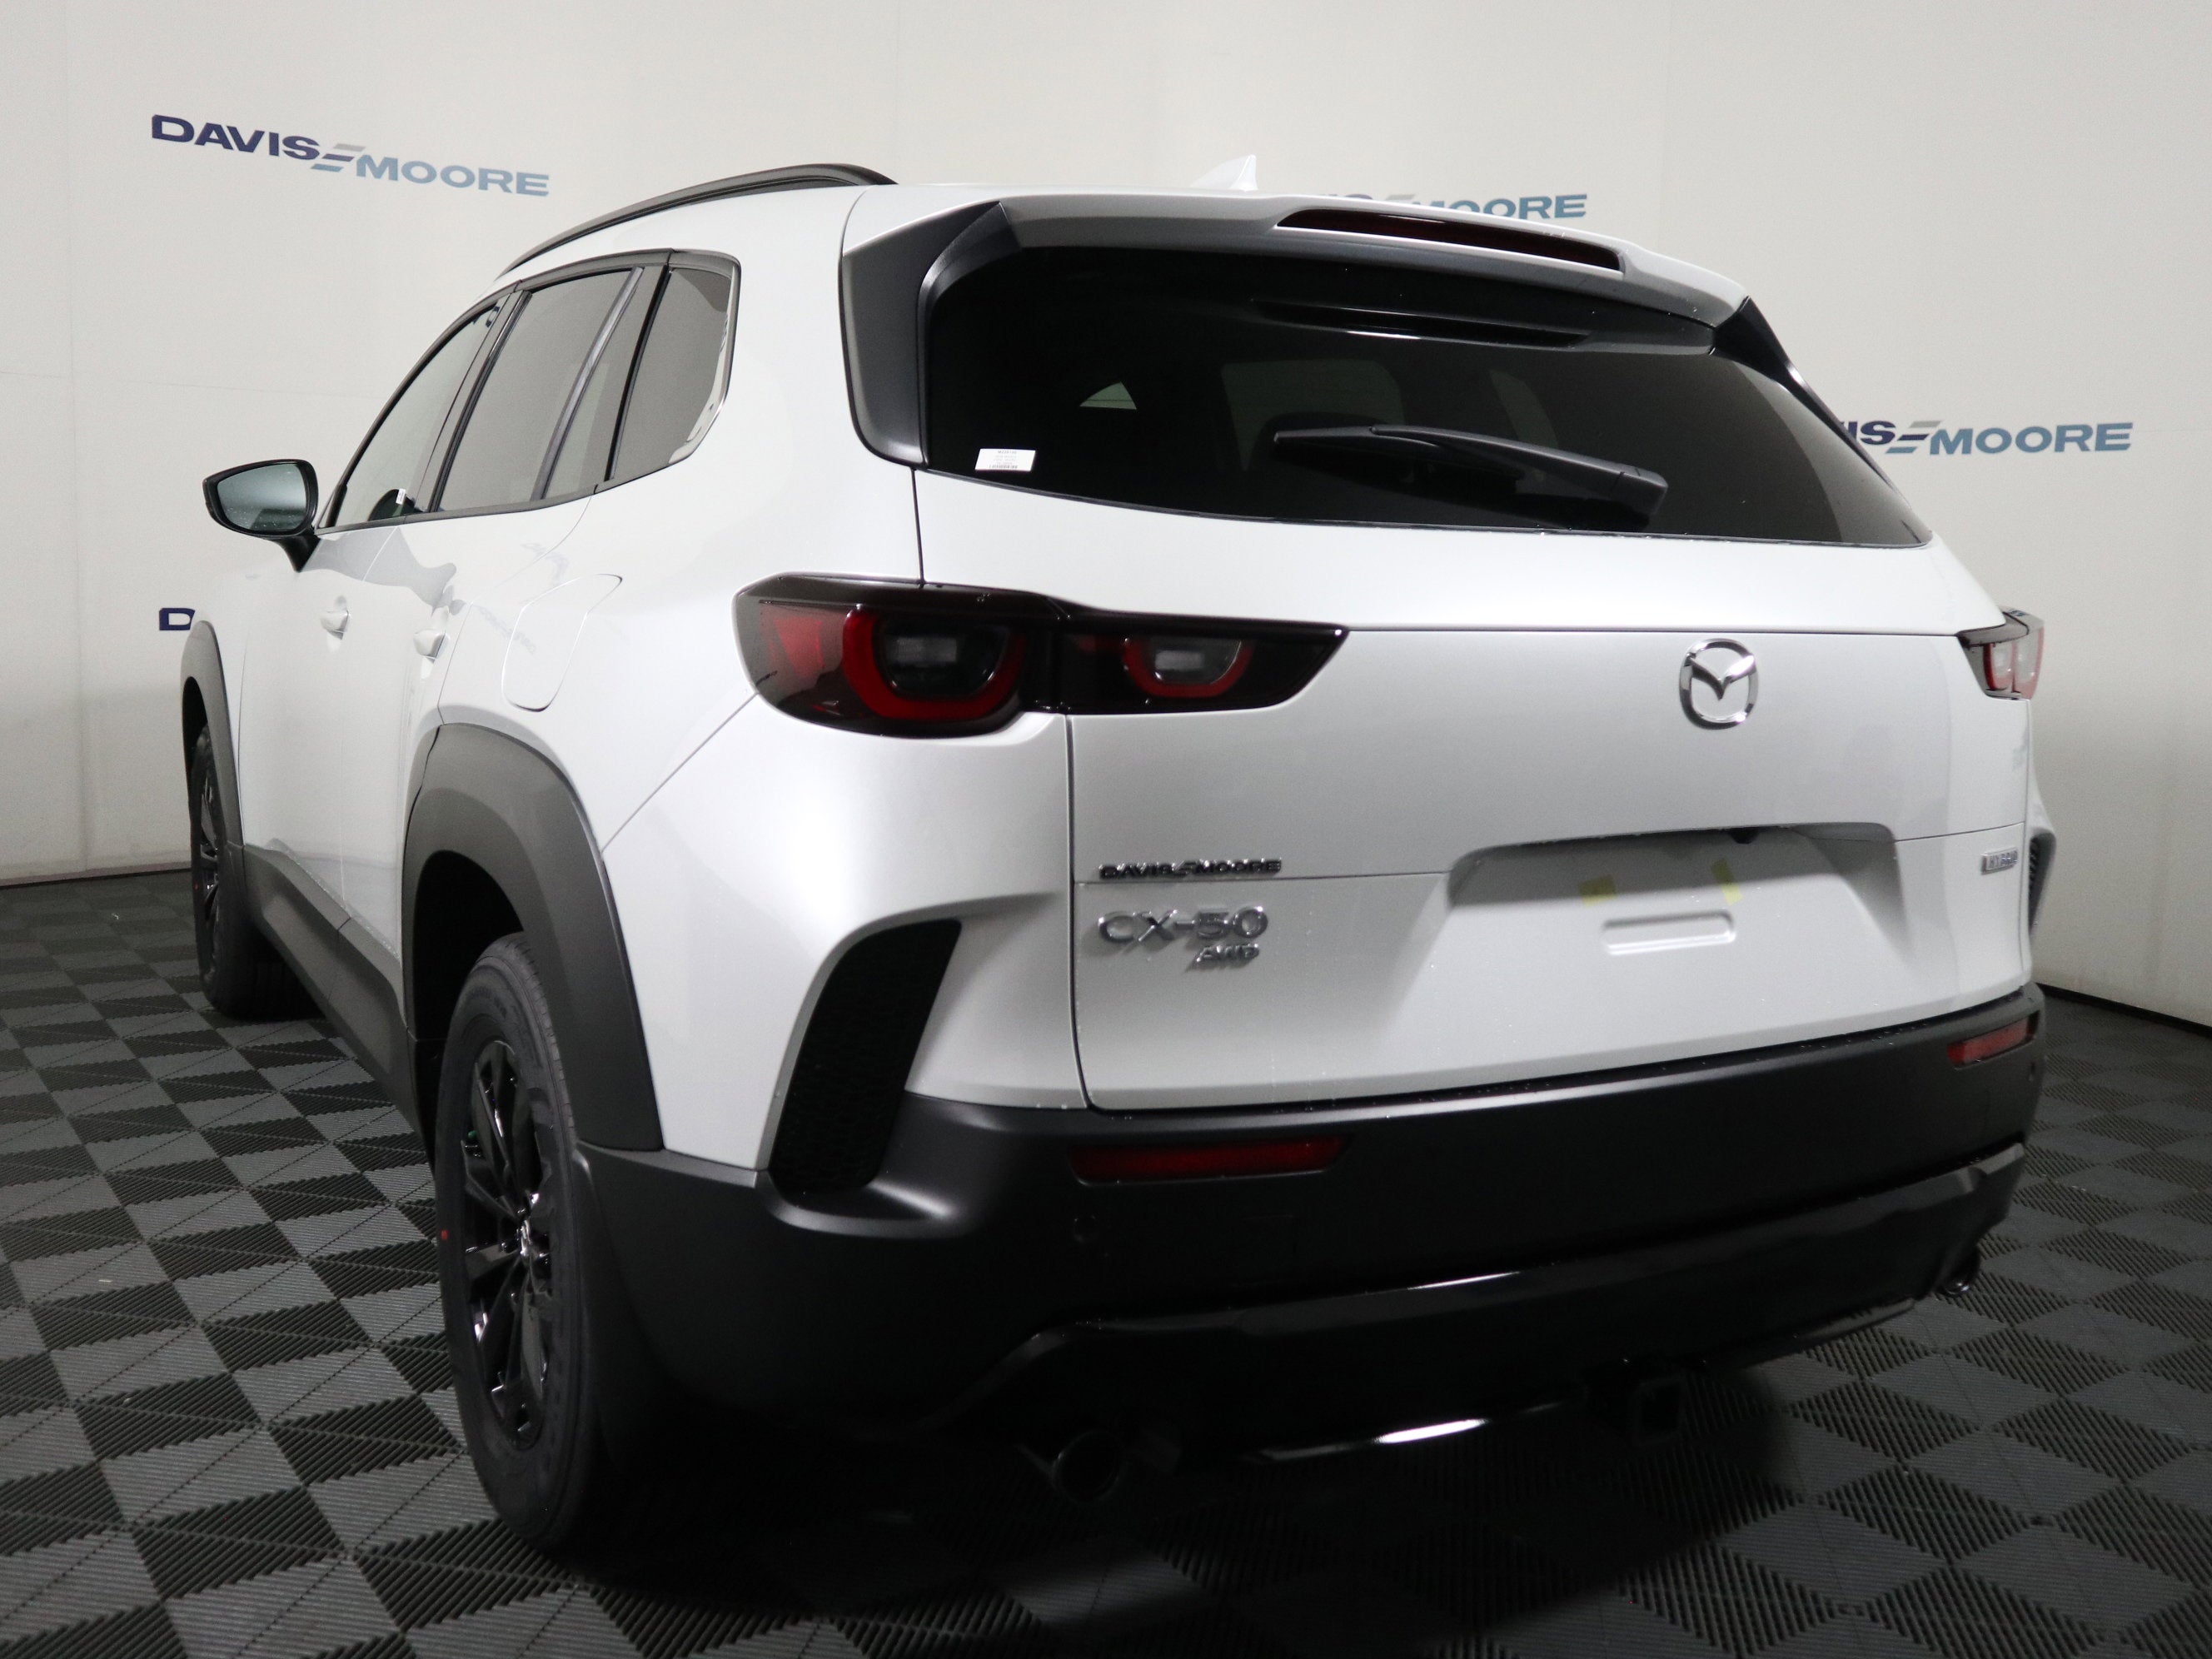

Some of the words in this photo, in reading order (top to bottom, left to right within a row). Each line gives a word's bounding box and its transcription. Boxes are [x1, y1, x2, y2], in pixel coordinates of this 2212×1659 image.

[152, 114, 320, 161] DAVIS
[356, 153, 550, 197] MOORE
[1929, 422, 2134, 455] MOORE
[1098, 906, 1268, 944] CX-50
